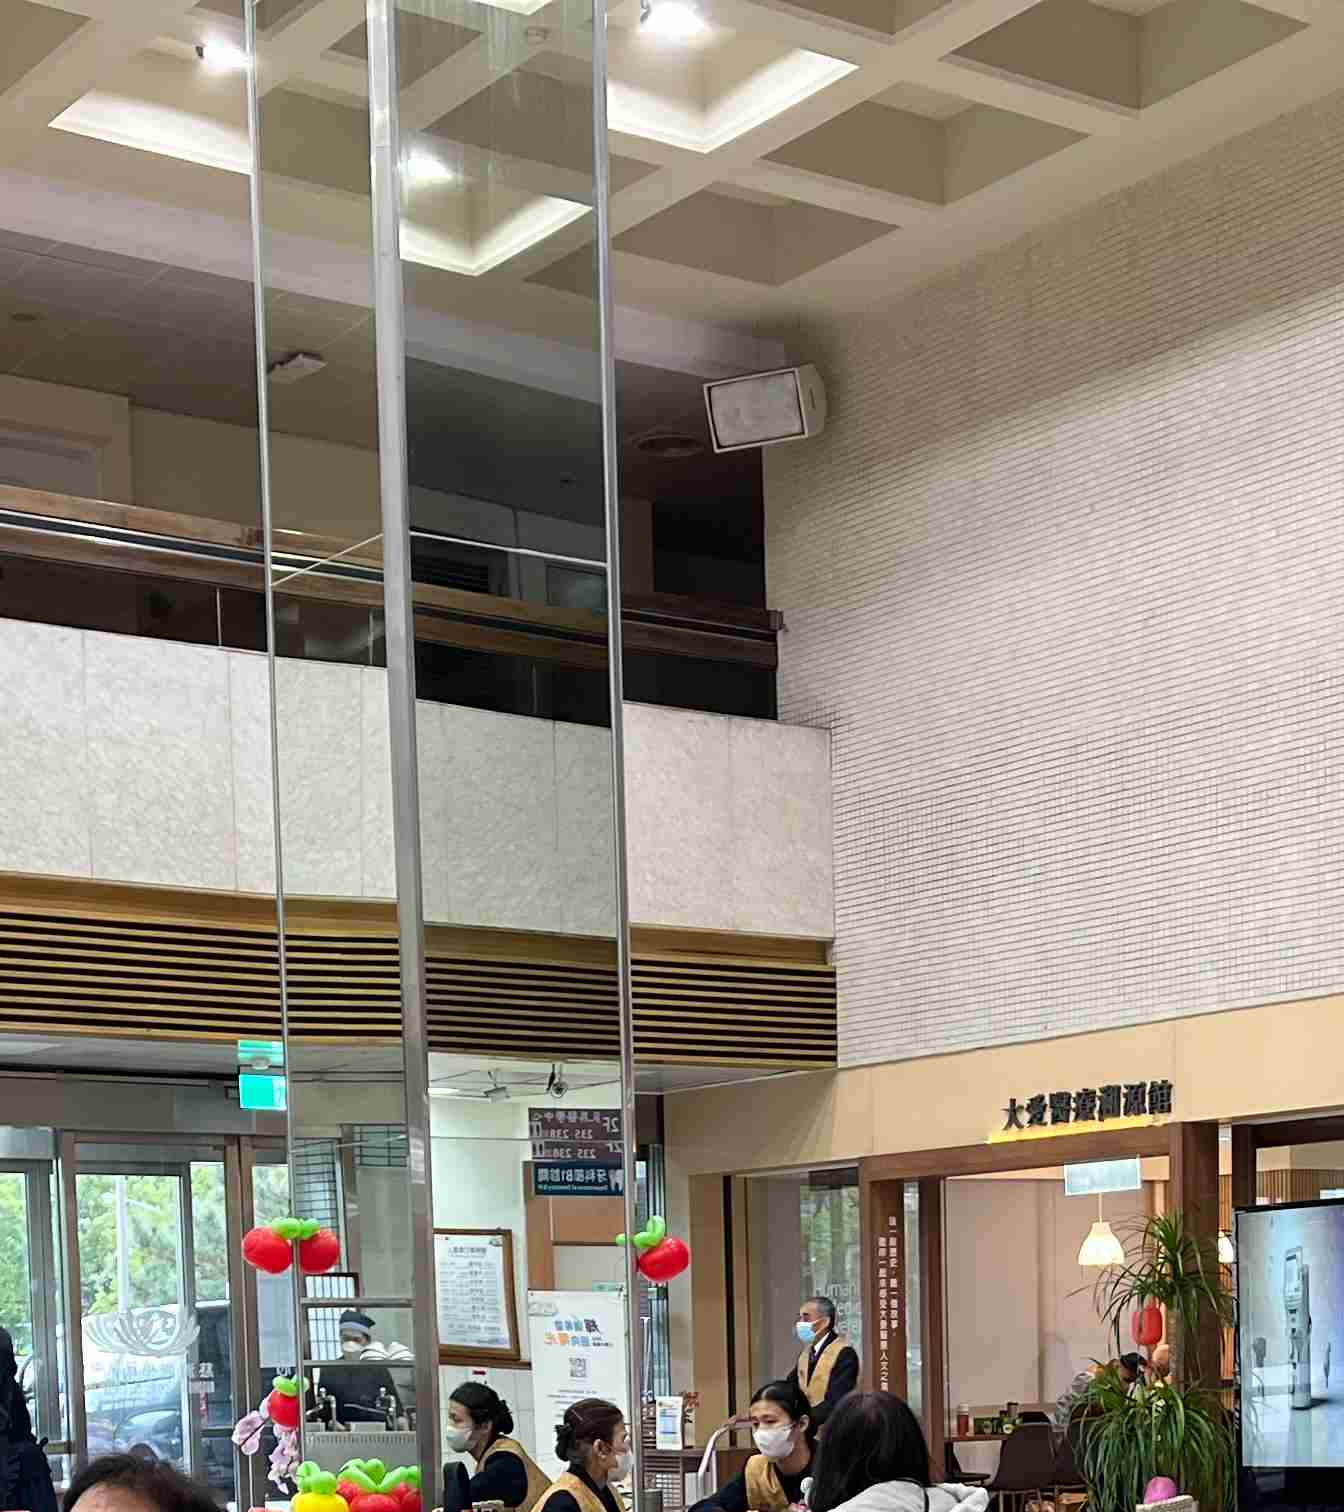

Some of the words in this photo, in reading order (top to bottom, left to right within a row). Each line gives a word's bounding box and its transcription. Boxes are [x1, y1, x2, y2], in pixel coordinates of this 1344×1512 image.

[1002, 1079, 1174, 1132] 大愛醫療溯源館
